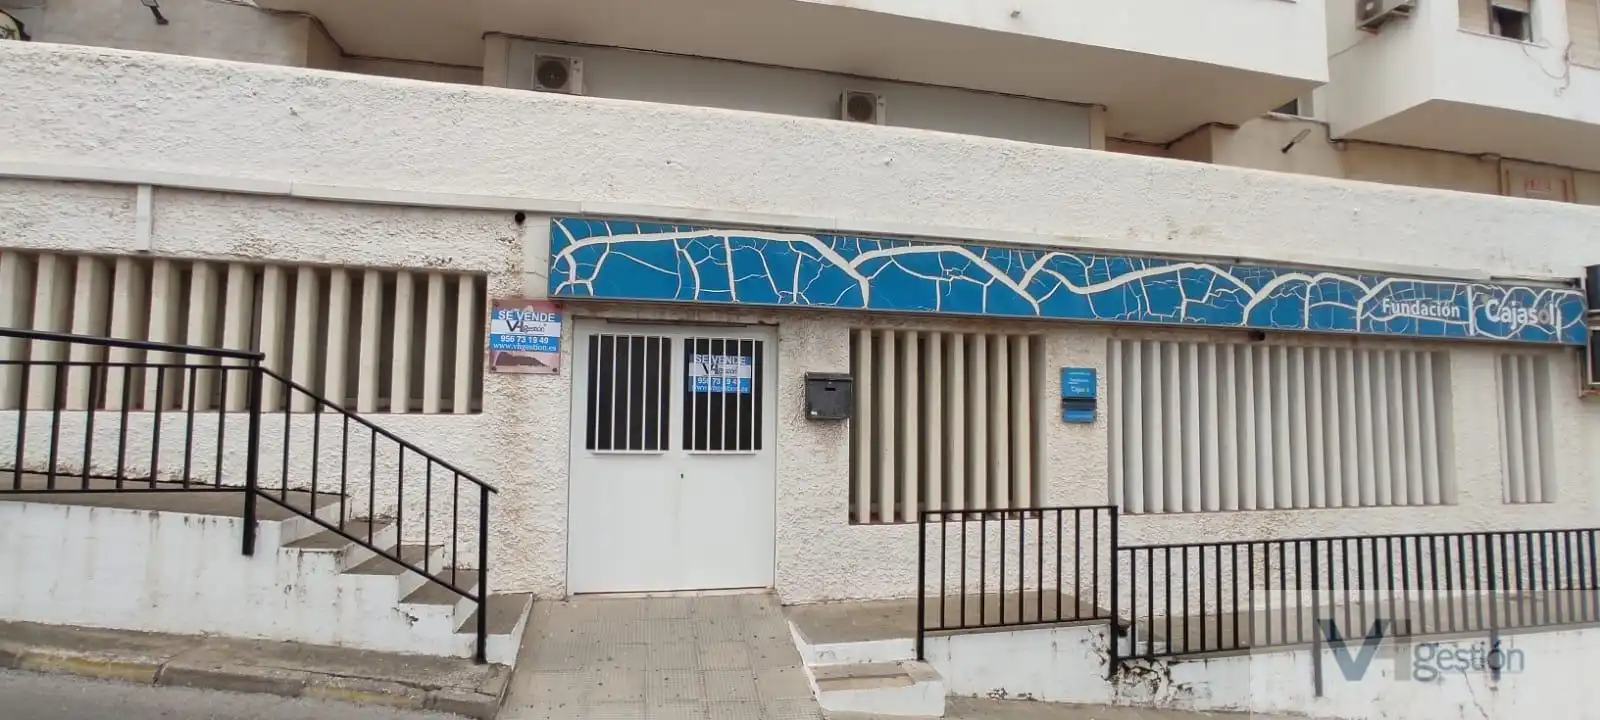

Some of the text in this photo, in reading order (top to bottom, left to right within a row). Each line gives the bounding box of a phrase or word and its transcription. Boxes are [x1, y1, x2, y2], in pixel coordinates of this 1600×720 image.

[498, 310, 556, 322] SE VENDE
[1382, 298, 1461, 318] Fundación
[1484, 299, 1556, 330] Cajasol
[500, 335, 515, 343] 956
[528, 336, 538, 344] 19
[538, 337, 549, 345] 49
